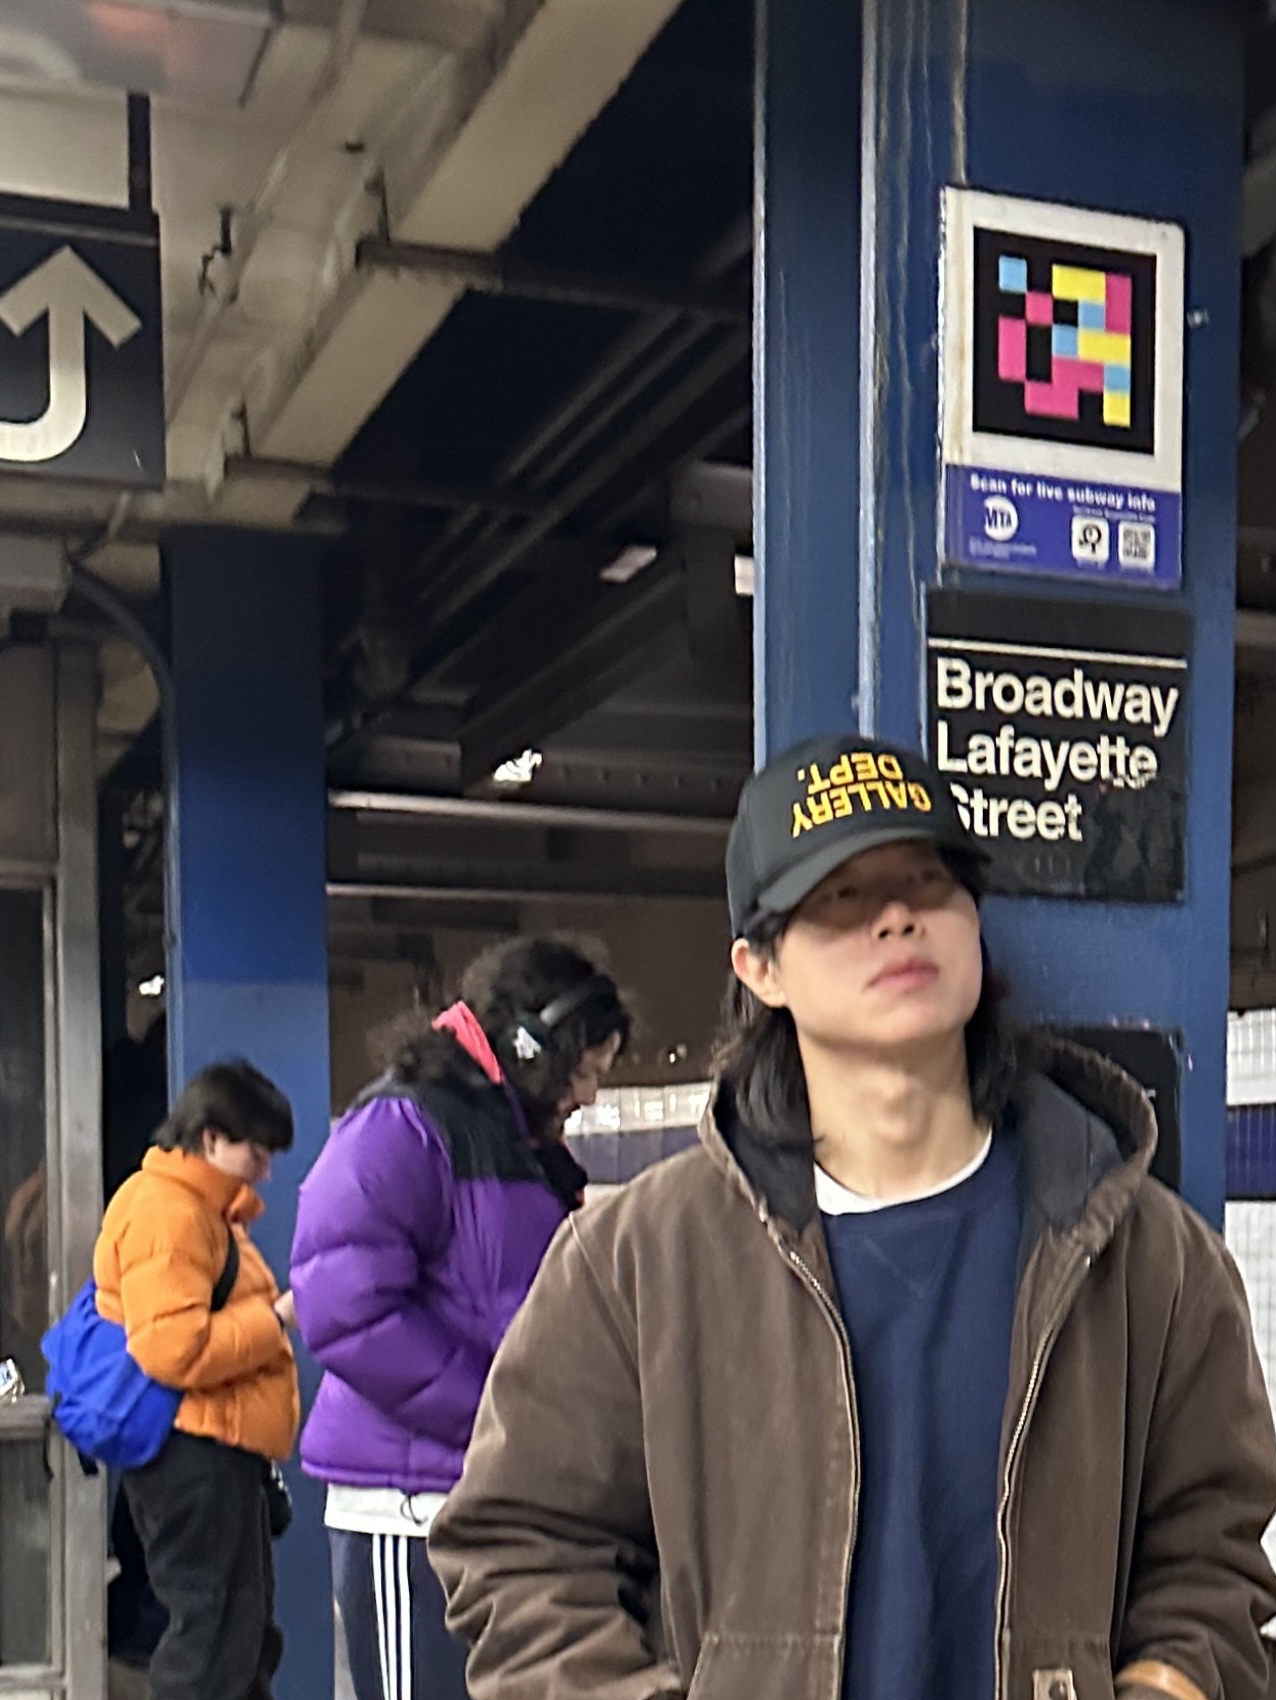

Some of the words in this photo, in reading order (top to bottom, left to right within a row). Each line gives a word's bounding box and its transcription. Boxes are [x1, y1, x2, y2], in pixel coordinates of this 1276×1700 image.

[970, 473, 1007, 493] Scan
[1011, 478, 1033, 497] for
[1036, 481, 1063, 501] live
[1067, 487, 1124, 510] subway
[1128, 492, 1156, 512] info
[937, 657, 1179, 737] Broadway
[797, 752, 903, 795] DEPT.
[937, 720, 1158, 791] Lafayette
[792, 781, 932, 838] GALLERY
